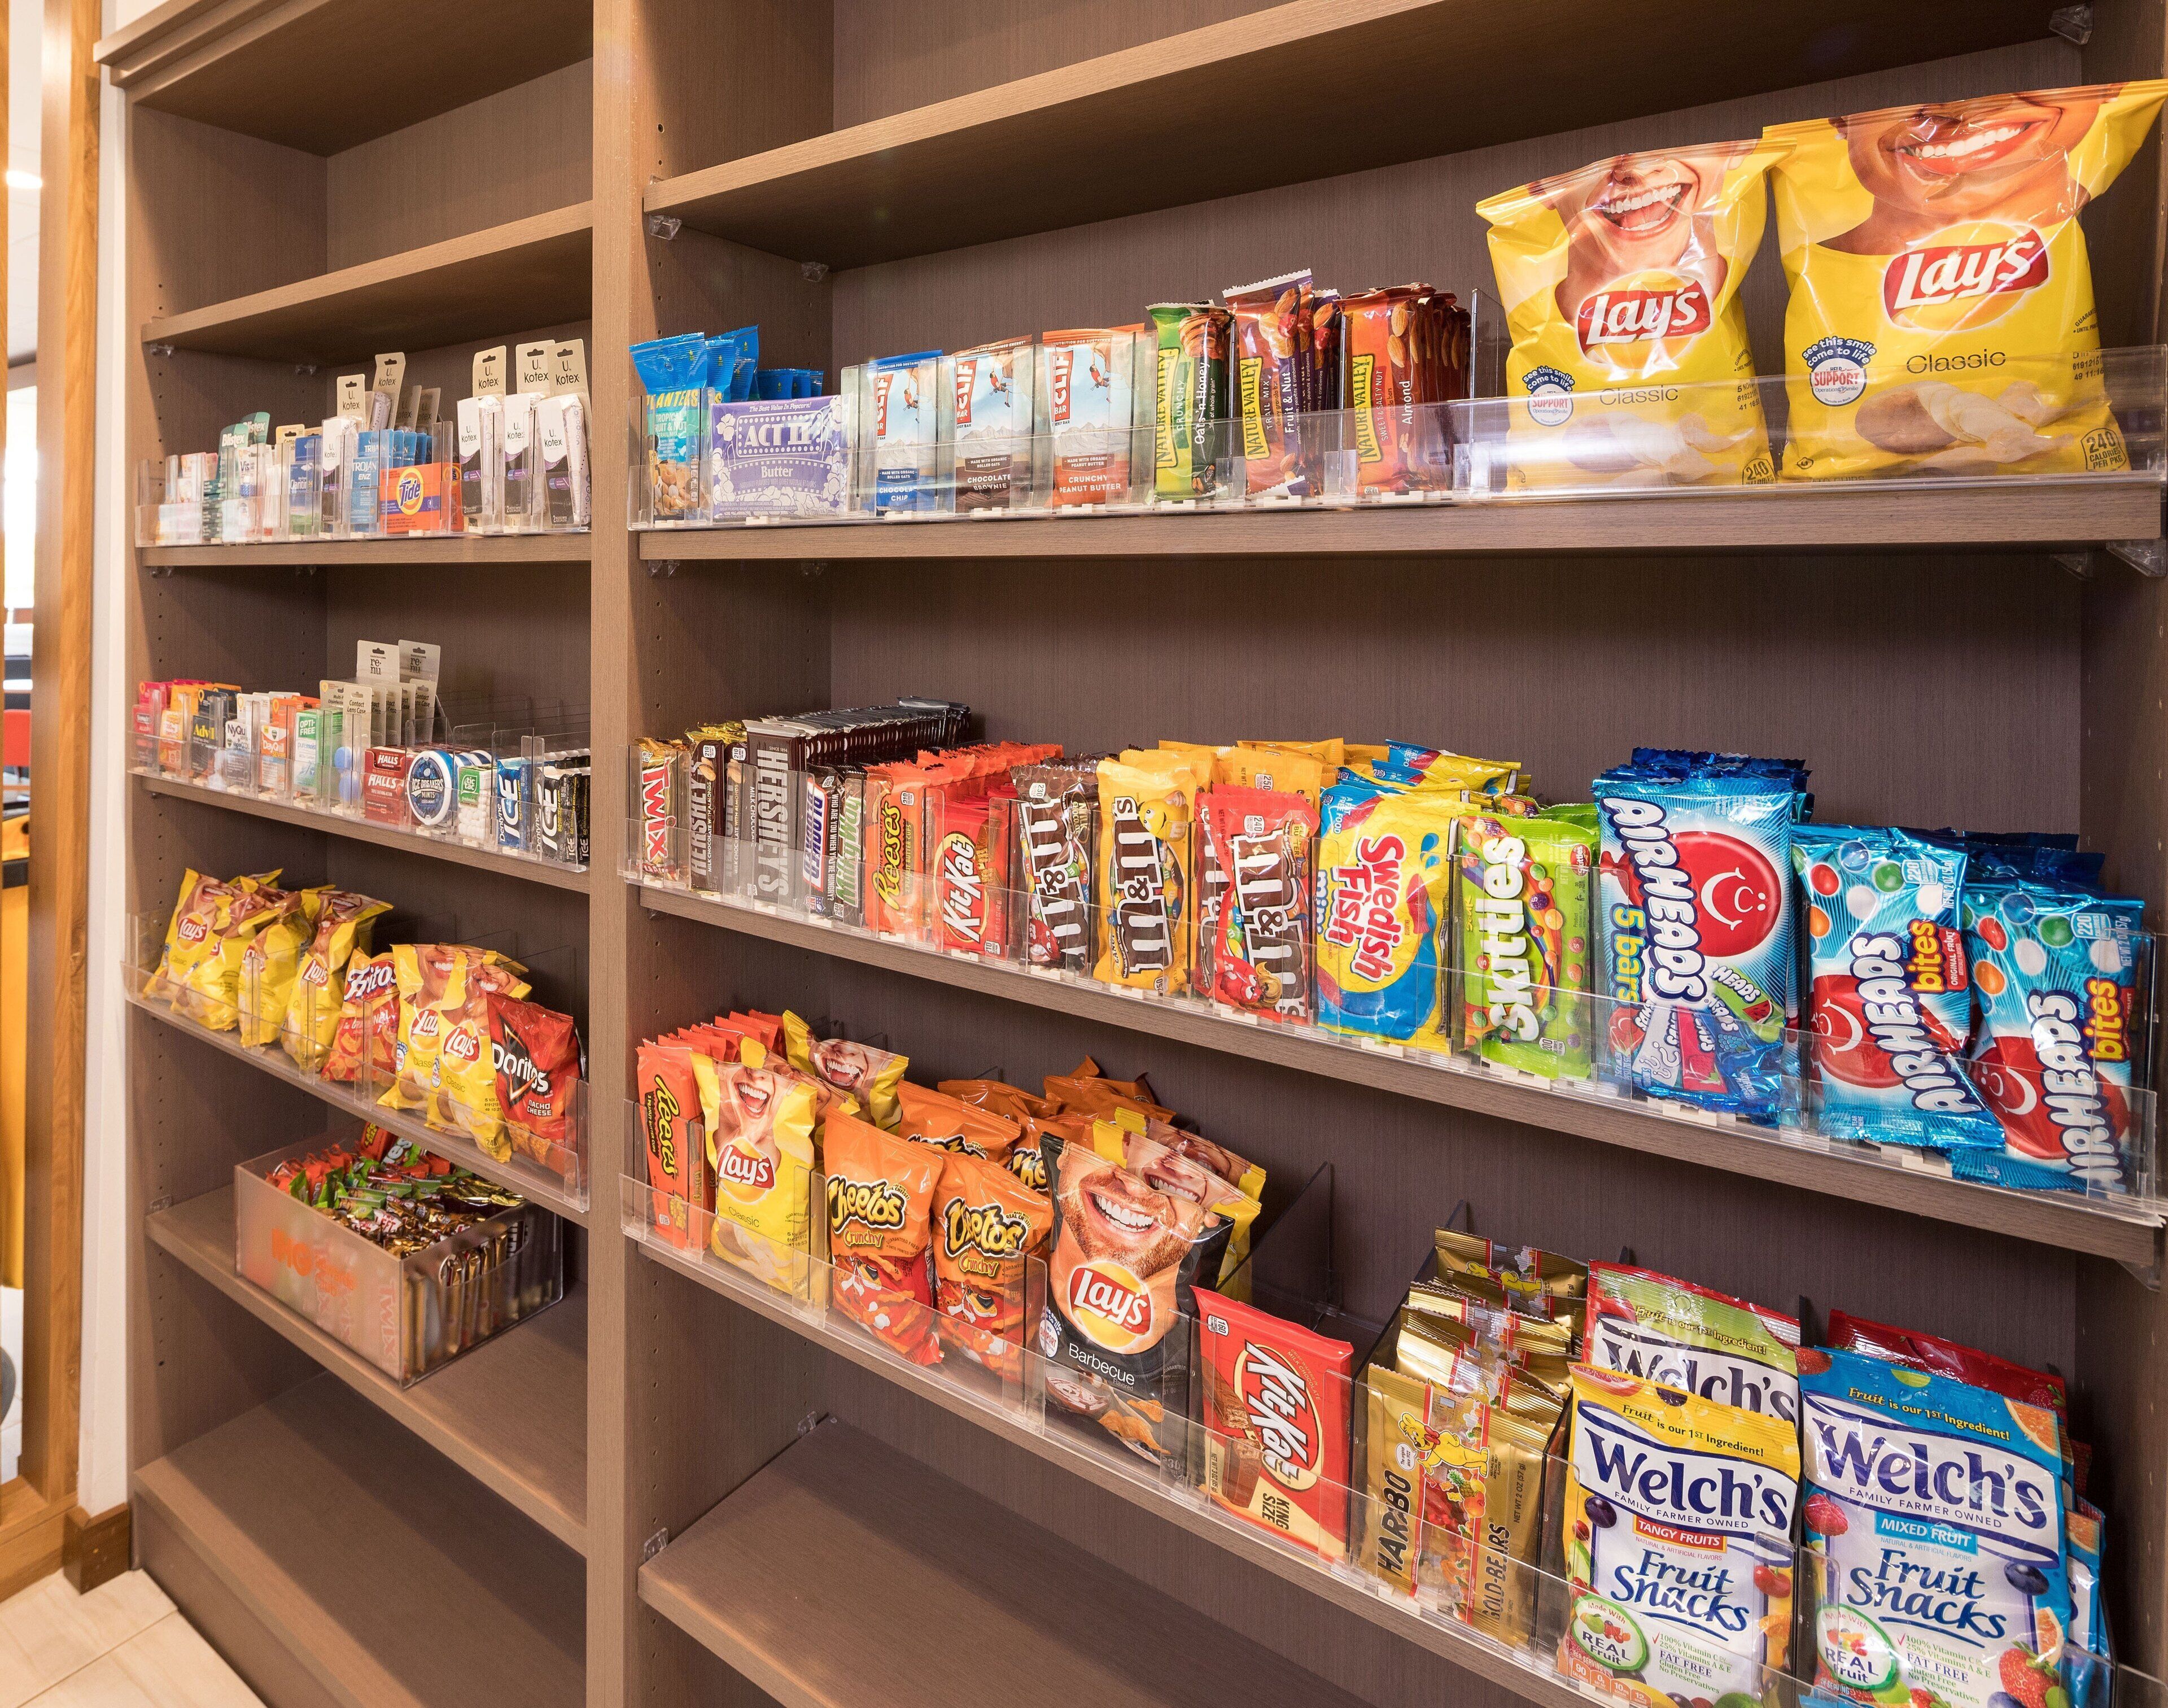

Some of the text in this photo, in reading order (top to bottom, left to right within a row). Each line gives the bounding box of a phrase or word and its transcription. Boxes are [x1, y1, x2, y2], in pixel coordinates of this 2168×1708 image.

[1894, 237, 2036, 309] Lay's
[1586, 287, 1700, 344] Lay's
[1803, 337, 1876, 359] see this smile
[1807, 347, 1870, 367] come to life
[1907, 349, 2006, 374] Classic
[957, 365, 973, 410] CLIF
[1055, 359, 1070, 405] CLIF
[1814, 372, 1859, 386] SUPPORT
[1242, 362, 1265, 456] NATURE VALLEY
[1282, 372, 1295, 434] Fruit & Nut
[1399, 380, 1412, 425] Almond
[1532, 398, 1568, 408] SUPPORT
[1599, 385, 1678, 405] Classic
[1055, 406, 1066, 414] BAR
[1265, 403, 1273, 430] TRAIL
[1354, 361, 1376, 459] NATURE VALLEY
[745, 422, 811, 448] ACT II
[1377, 417, 1387, 441] SWEET
[2086, 435, 2116, 452] 240
[761, 466, 793, 478] Butter
[1069, 474, 1107, 483] CRUNCHY
[1746, 462, 1768, 479] 240
[399, 479, 421, 506] Tide
[1059, 484, 1089, 493] PEANUT
[300, 720, 315, 728] OPTI-
[300, 727, 315, 735] FREE
[378, 754, 398, 764] HALLS
[368, 775, 396, 788] HALLS
[412, 779, 443, 791] ICE BREAKERS
[499, 774, 520, 838] ICE
[643, 758, 671, 862] TWIX
[757, 750, 789, 896] HERSHEY'S
[872, 801, 901, 911] Reese's
[1908, 860, 1919, 881] 220
[1326, 867, 1365, 946] Fish
[1352, 835, 1407, 981] Swedish
[1603, 798, 1706, 1001] AIRHEADS
[178, 919, 206, 939] Lay's
[2078, 915, 2091, 937] 220
[1614, 907, 1645, 1008] 5 bars
[1913, 922, 1943, 992] bites
[344, 966, 396, 999] Fritos
[1851, 936, 1981, 1112] AIRHEADS
[2091, 980, 2122, 1060] bites
[445, 1033, 477, 1056] Lay's
[492, 1042, 549, 1092] Doritos
[446, 1076, 465, 1092] Classic
[527, 1106, 552, 1116] CHEESE
[528, 1099, 550, 1109] NACHO
[719, 1145, 770, 1185] Lay's
[728, 1207, 759, 1227] Classic
[828, 1178, 904, 1228] Cheetos
[843, 1229, 883, 1248] Crunchy
[959, 1253, 998, 1277] Crunchy
[1073, 1269, 1148, 1327] Lay's
[1068, 1342, 1135, 1386] Barbecue
[1113, 1377, 1133, 1391] Flavored
[1848, 1388, 2010, 1441] Fruit is our 1ST Ingredient!
[1623, 1405, 1764, 1457] Fruit is our 1ST Ingredient!
[1585, 1427, 1788, 1530] Welch's
[1813, 1417, 2047, 1530] Welch's
[1262, 1492, 1275, 1523] SIZE
[1276, 1497, 1289, 1530] KING
[1615, 1492, 1749, 1528] FAMILY FARMER OWNED
[1850, 1487, 2002, 1527] FAMILY FARMER OWNED
[1378, 1469, 1411, 1576] HARIBO
[1640, 1521, 1720, 1547] TANGY FRUITS
[1881, 1519, 1972, 1547] MIXED FRUIT
[1636, 1537, 1660, 1547] NATURAL
[1667, 1547, 1696, 1557] ARTIFICIAL
[1637, 1549, 1734, 1594] Fruit
[1877, 1548, 1985, 1598] Fruit
[1611, 1565, 1750, 1632] Snacks
[1847, 1567, 2007, 1639] Snacks
[1583, 1631, 1630, 1661] REAL
[1590, 1645, 1620, 1666] Fruit
[1660, 1634, 1711, 1657] 100% Vitamin
[1660, 1641, 1712, 1666] 25% Vitamins
[1659, 1650, 1712, 1678] FAT FREE
[1659, 1659, 1701, 1679] Gluten Free
[1826, 1648, 1878, 1676] REAL
[1833, 1661, 1868, 1684] Fruit
[1907, 1653, 1969, 1683] FAT FREE
[1671, 1669, 1720, 1693] Preservatives
